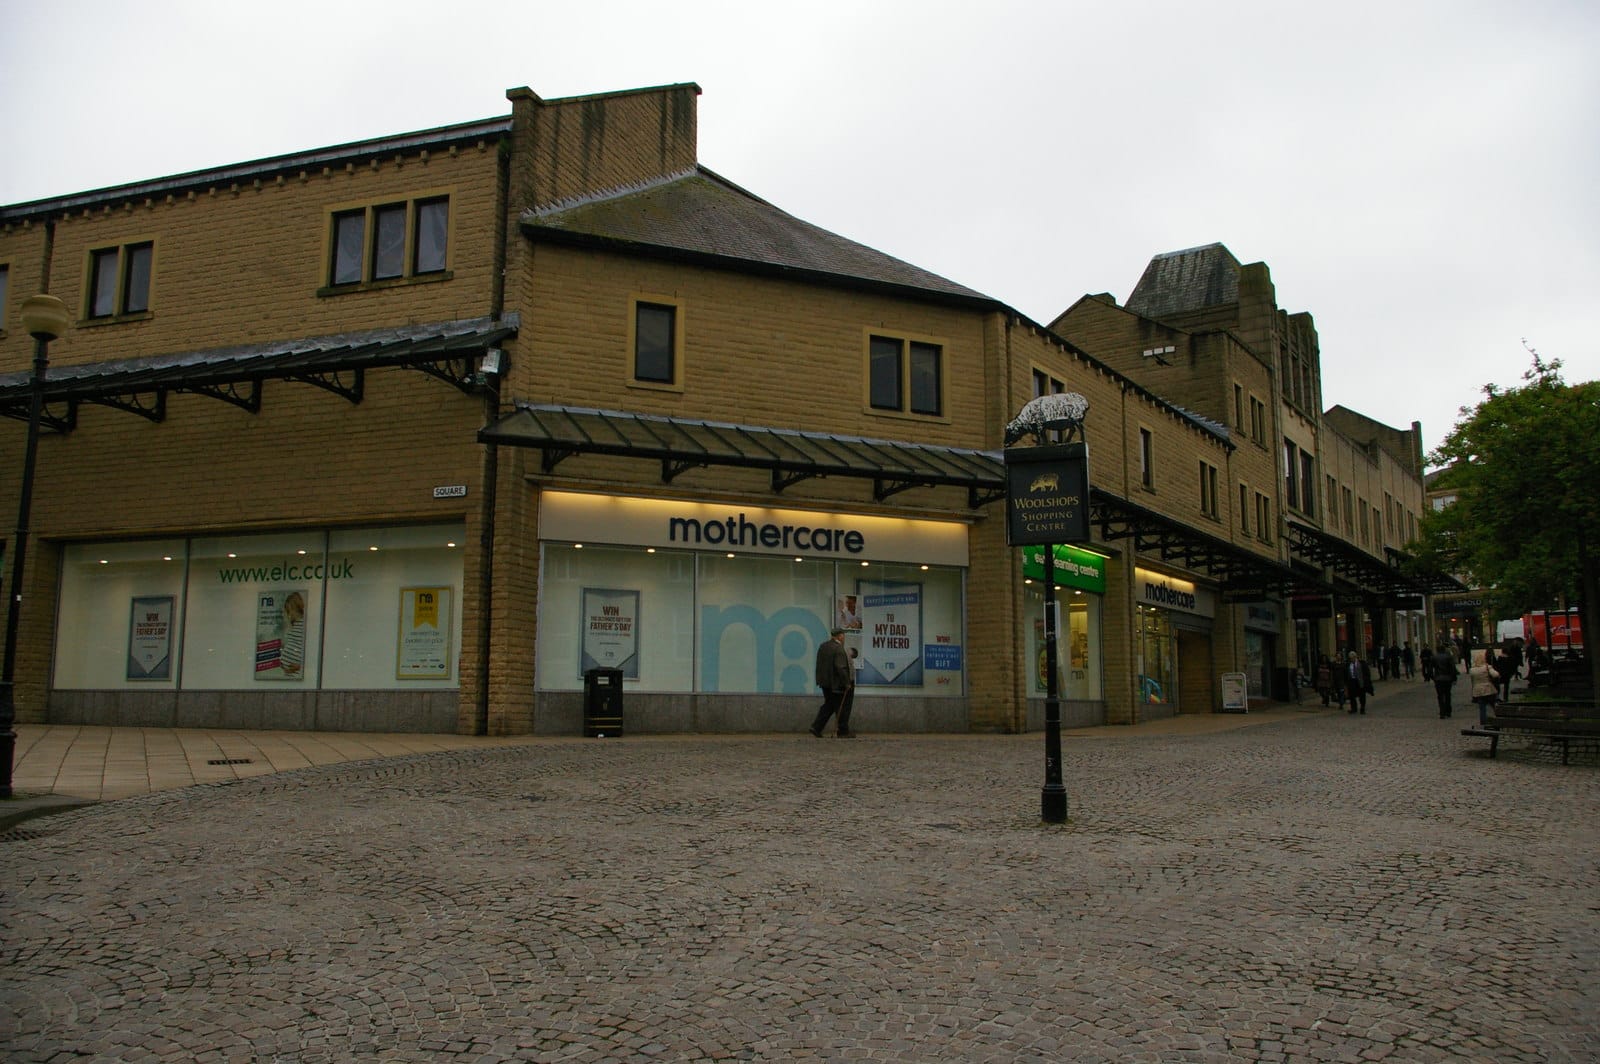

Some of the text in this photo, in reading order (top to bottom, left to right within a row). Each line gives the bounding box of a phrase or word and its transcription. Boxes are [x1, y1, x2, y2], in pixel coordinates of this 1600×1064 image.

[435, 487, 464, 496] SQUARE
[1014, 496, 1079, 509] WOOLSHOPS
[1022, 511, 1073, 521] SHOPPING
[1026, 522, 1065, 532] CENTRE
[669, 513, 865, 553] mothercare
[1080, 565, 1099, 578] centre
[1145, 580, 1195, 609] mothercare
[603, 606, 619, 616] WIN
[886, 613, 895, 622] TO
[590, 622, 632, 632] FATHER'S DAY
[875, 624, 907, 636] MY DAD
[872, 636, 910, 649] MY HERO
